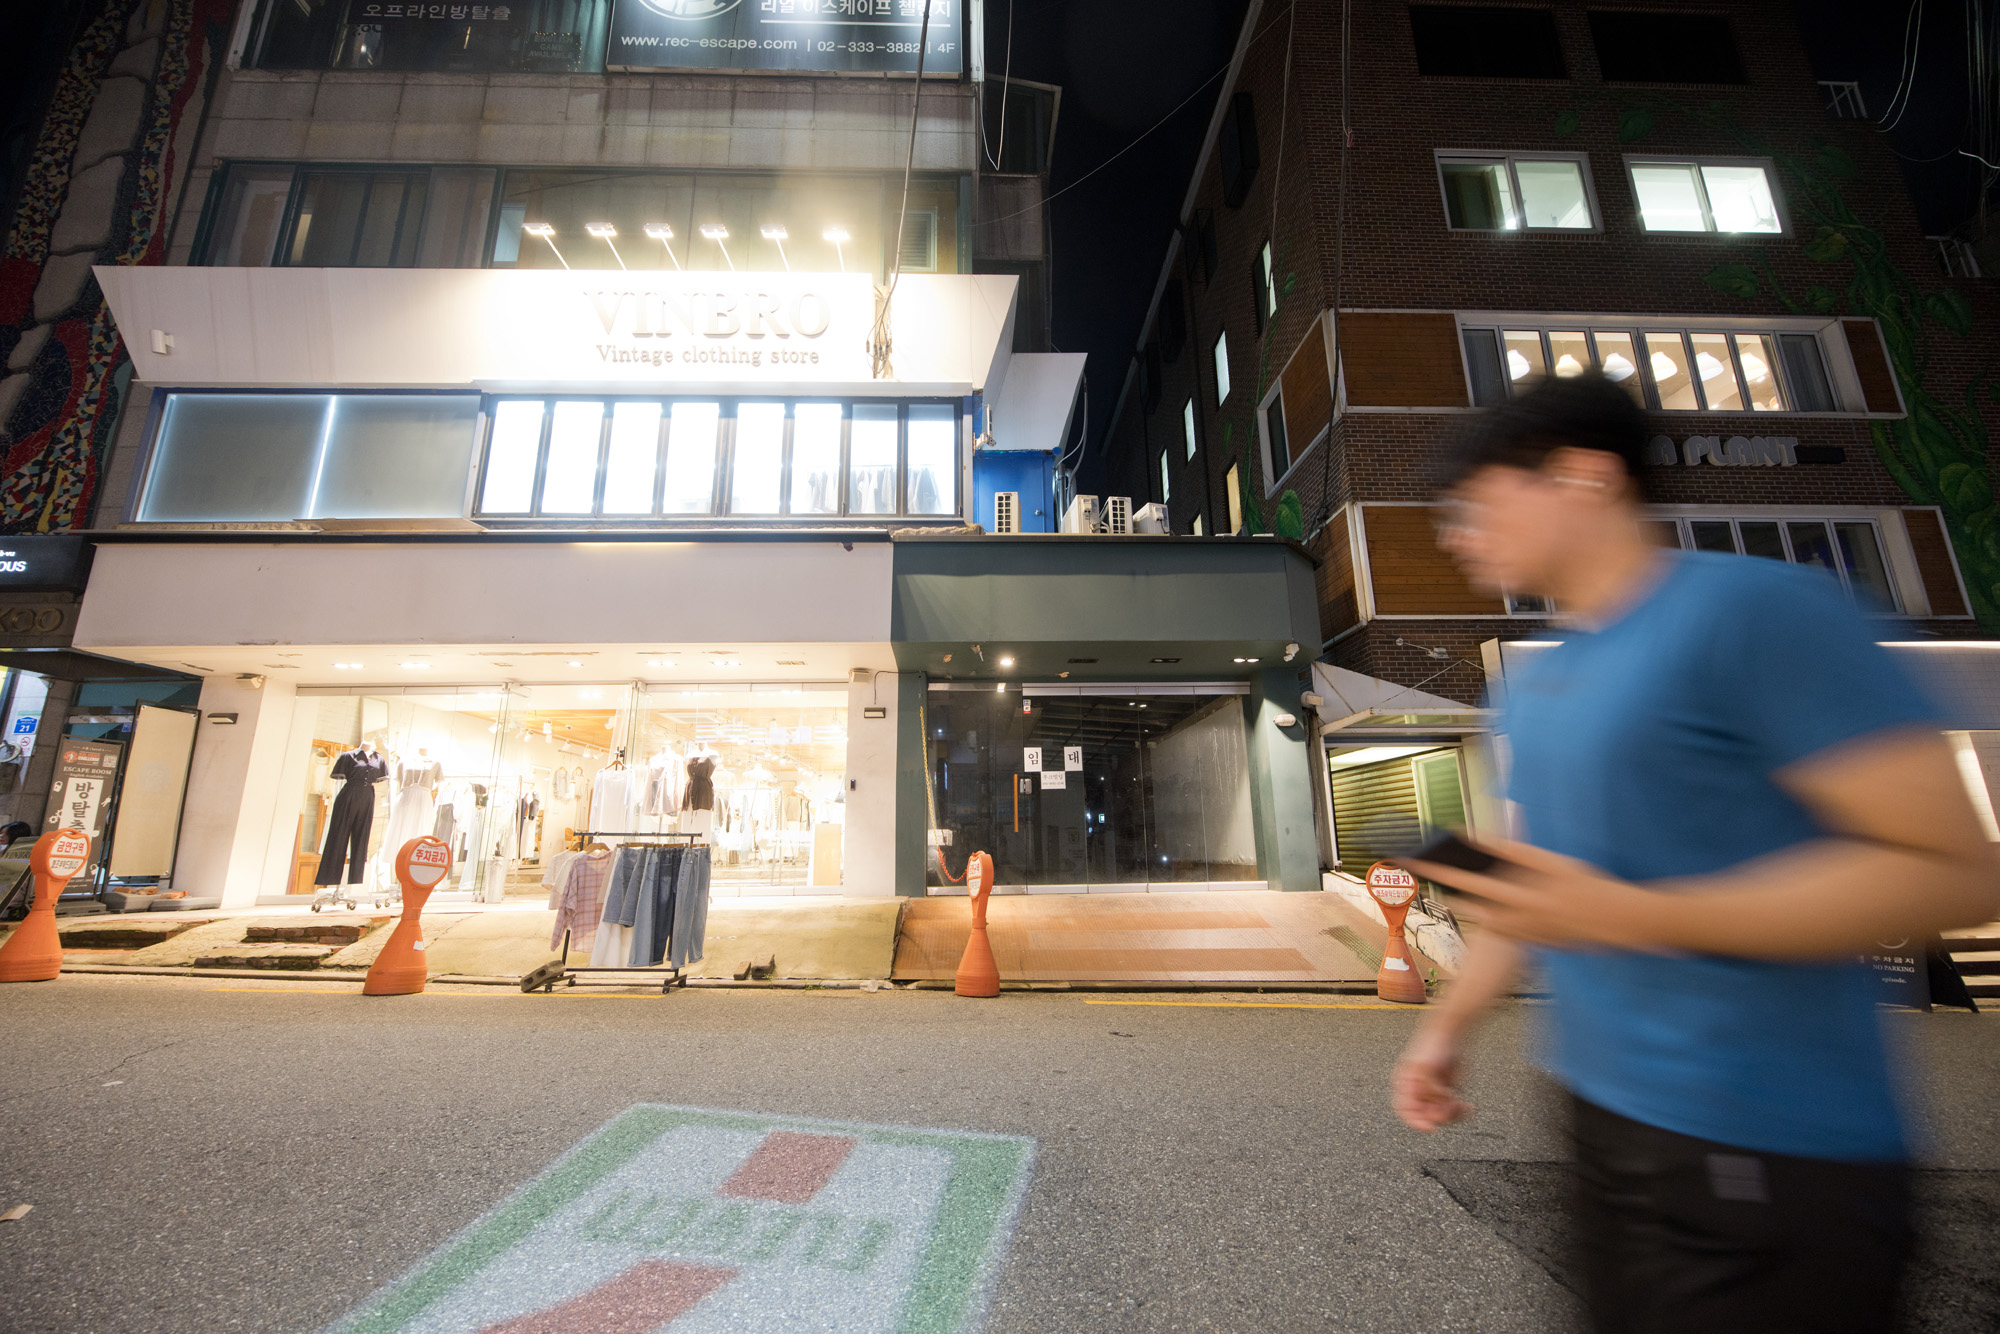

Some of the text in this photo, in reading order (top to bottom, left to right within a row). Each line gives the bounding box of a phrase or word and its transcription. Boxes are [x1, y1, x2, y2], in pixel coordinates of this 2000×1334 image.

[362, 4, 511, 20] 오프라인방탈출
[802, 0, 892, 15] 이스케이프
[621, 34, 955, 54] www.rec-escape.com 02-333-3882 4F
[583, 290, 831, 339] VINBRO
[596, 345, 819, 367] Vintage clothing store
[1682, 435, 1798, 466] PLANT
[1028, 751, 1079, 765] 임 대
[63, 766, 91, 774] ESCAPE
[56, 840, 85, 854] 금연구역
[416, 849, 446, 863] 주차금지
[1884, 965, 1915, 973] PARKING
